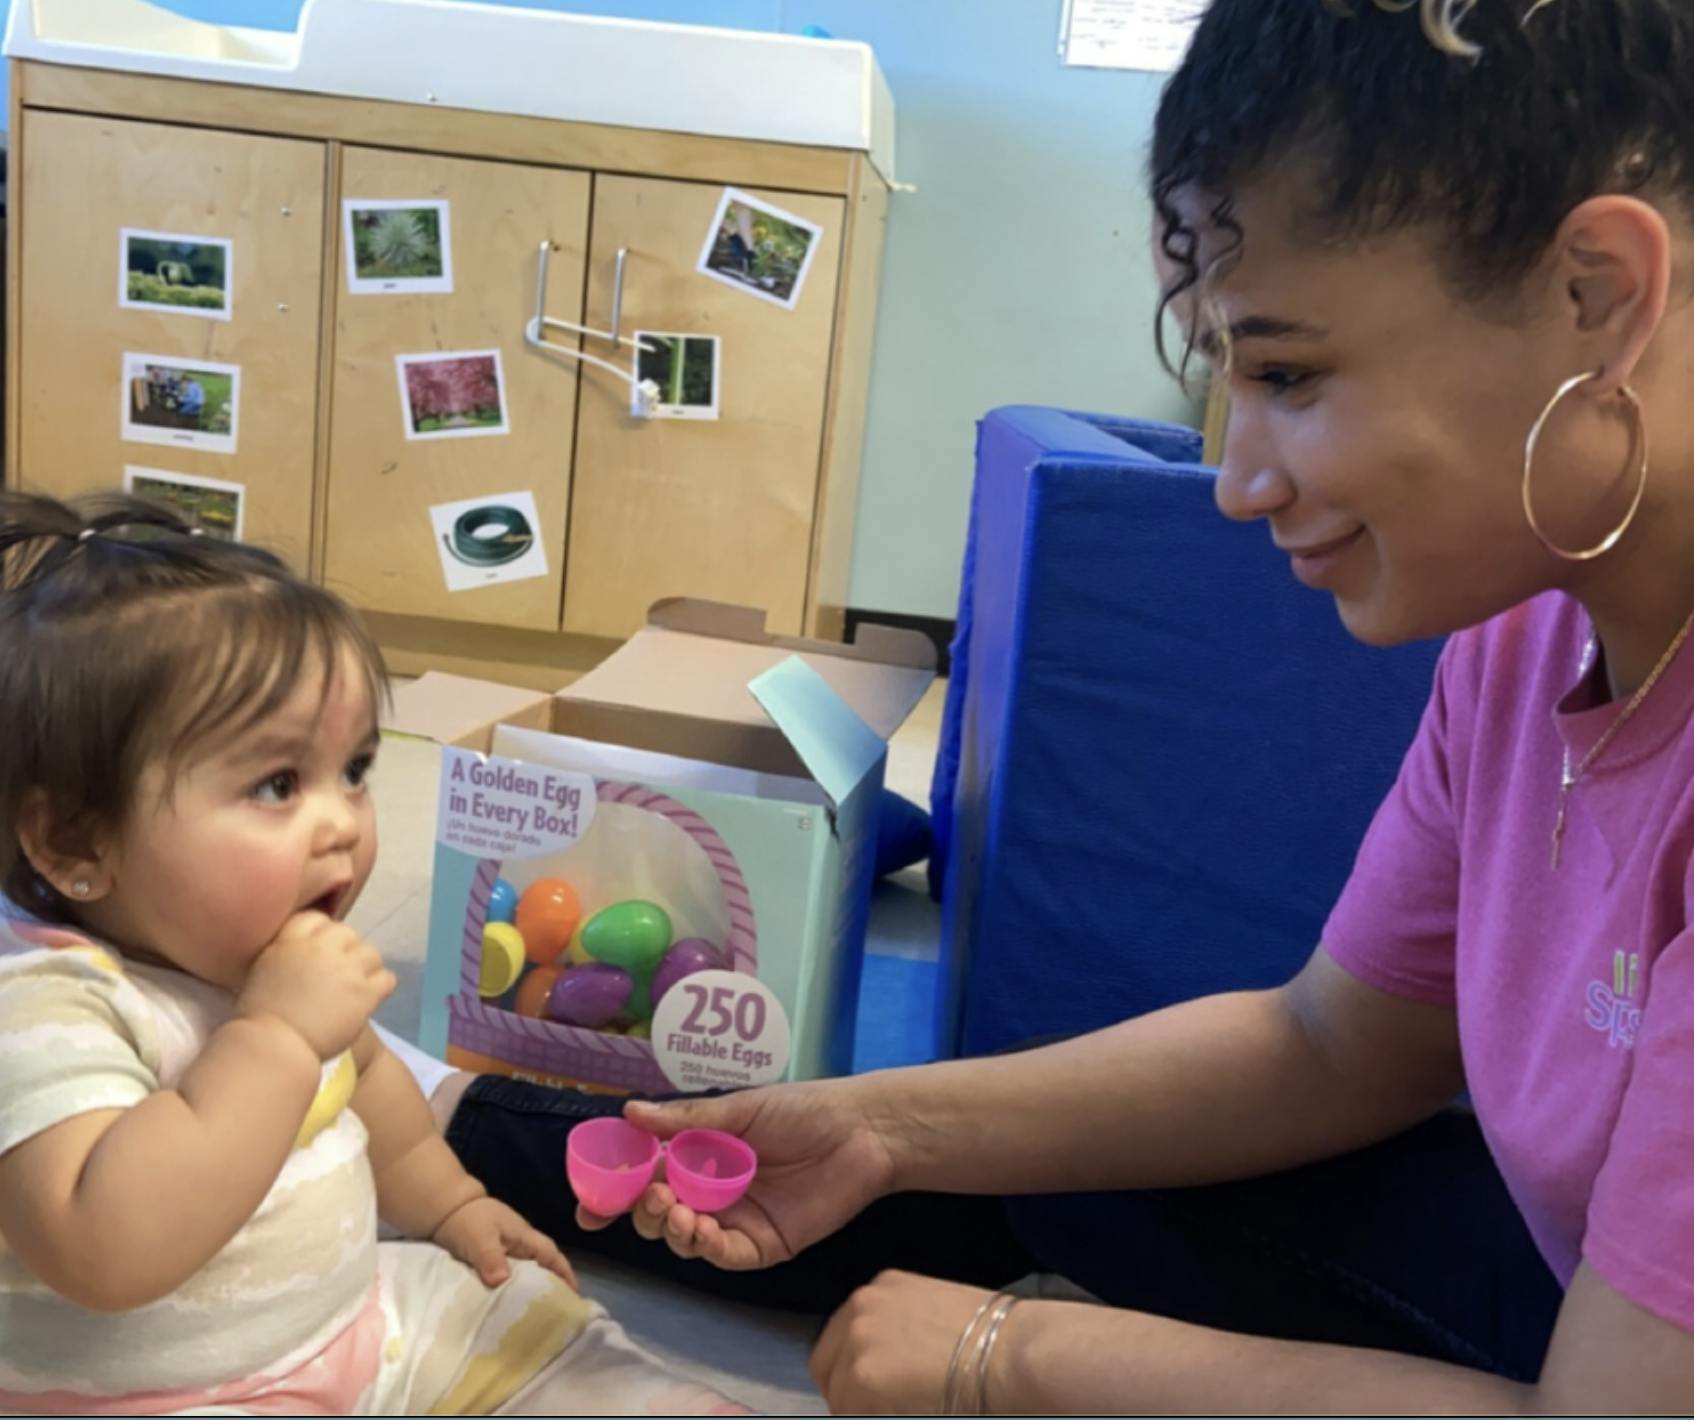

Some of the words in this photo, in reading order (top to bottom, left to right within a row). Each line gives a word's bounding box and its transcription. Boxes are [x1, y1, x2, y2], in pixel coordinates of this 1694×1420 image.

[451, 757, 465, 782] A
[469, 761, 539, 797] Golden
[543, 776, 581, 811] Egg
[449, 788, 467, 814] in
[472, 793, 529, 832] Every
[533, 806, 579, 838] Box!
[680, 984, 767, 1042] 250
[667, 1033, 728, 1060] Fillable
[731, 1043, 773, 1069] Eggs
[706, 1064, 751, 1081] huevos
